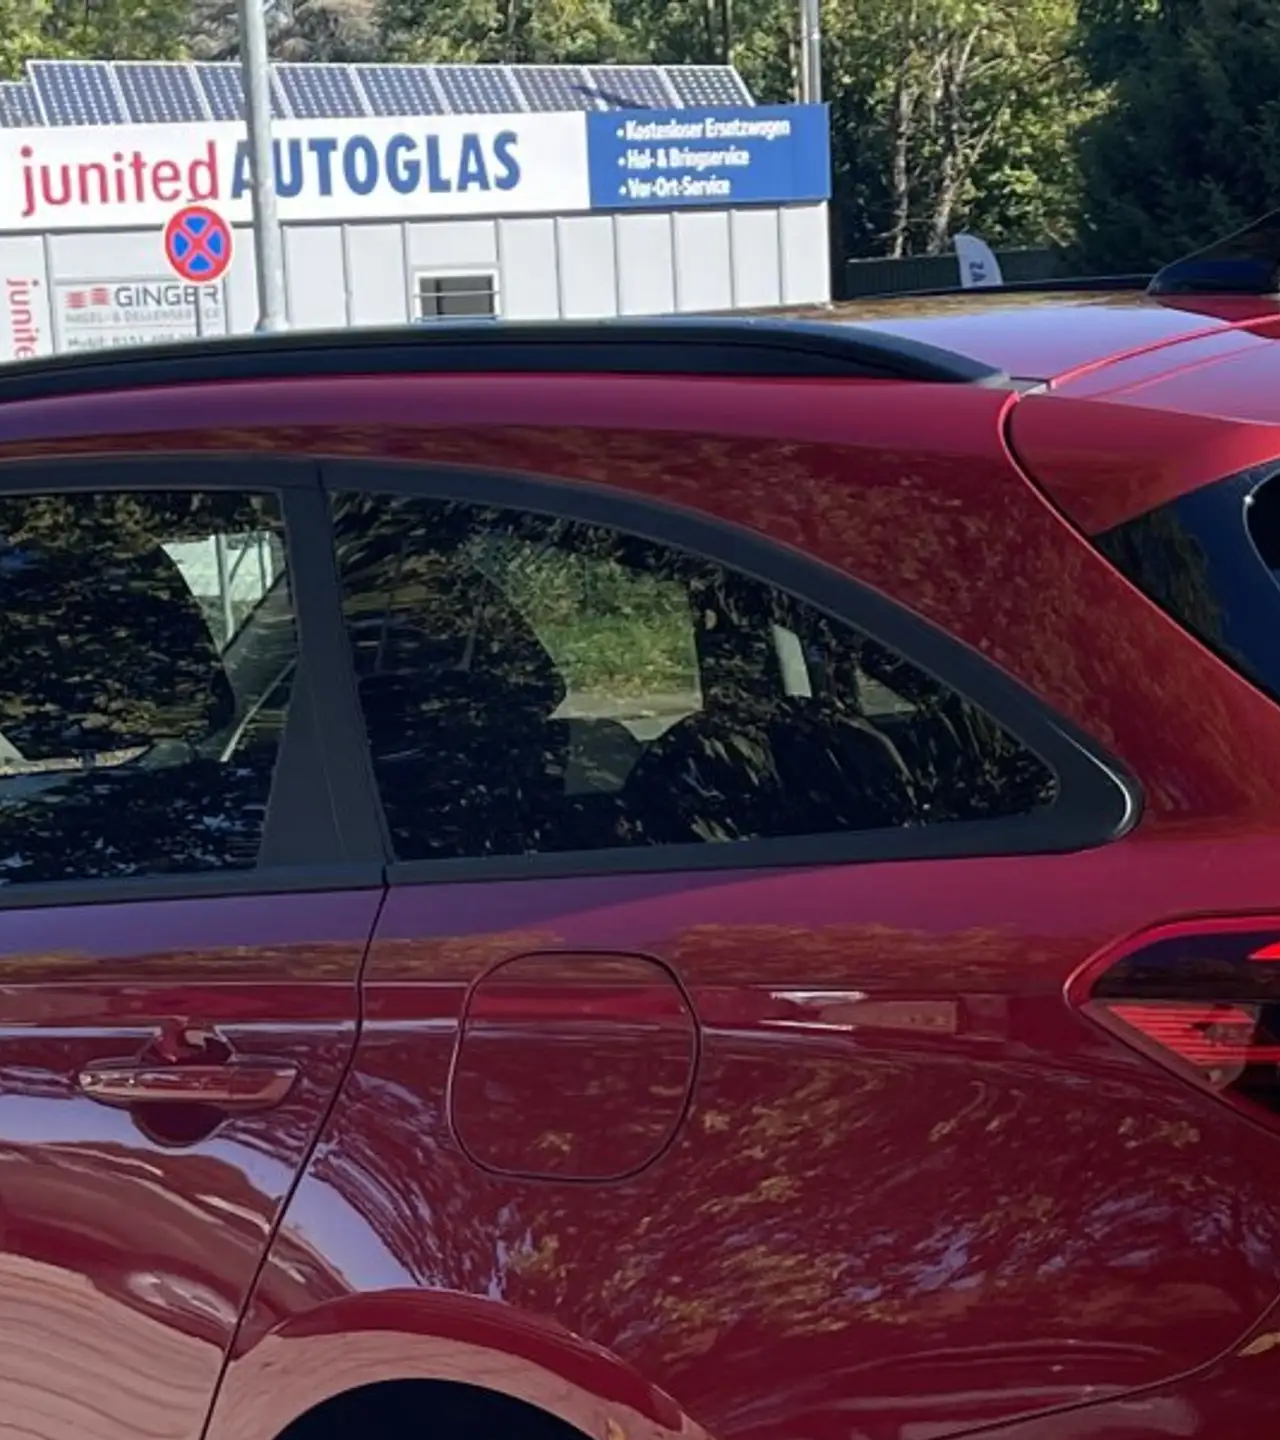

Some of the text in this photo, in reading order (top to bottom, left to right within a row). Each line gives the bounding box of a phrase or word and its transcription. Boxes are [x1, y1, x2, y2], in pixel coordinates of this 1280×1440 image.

[626, 116, 790, 140] Kostenloser Ersatzwagen
[669, 144, 750, 171] Bringservice
[21, 130, 520, 217] junited AUTOGLAS
[628, 174, 730, 198] Vor-Ort-Service
